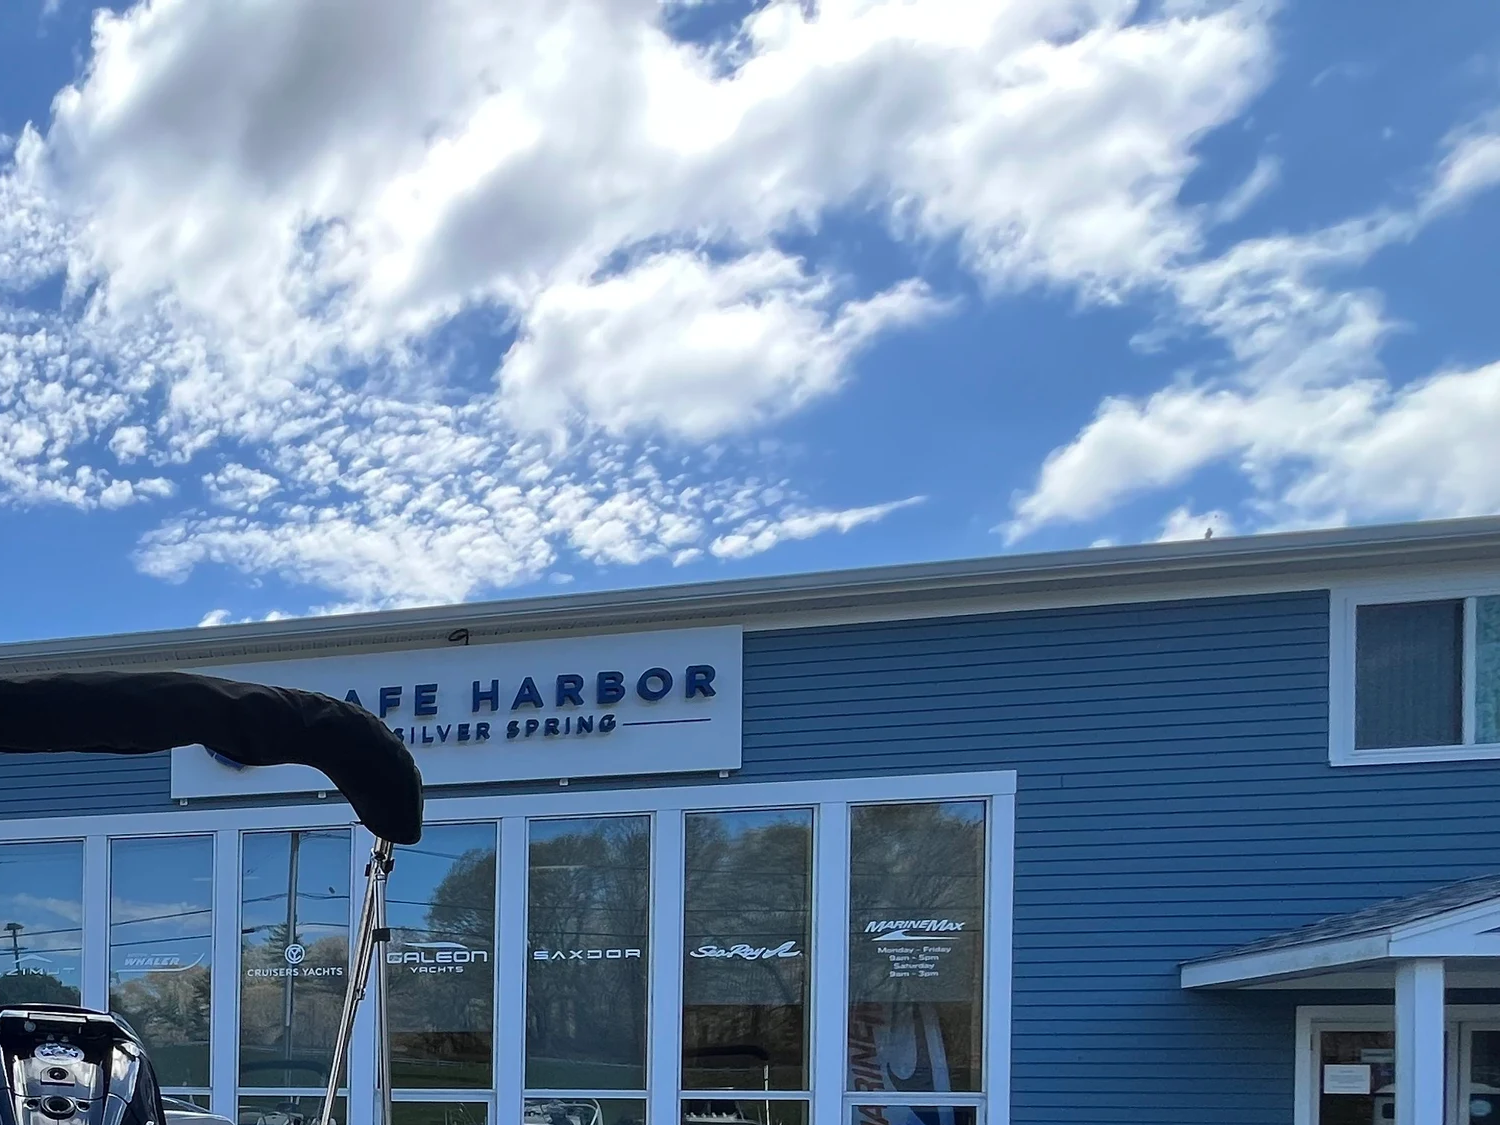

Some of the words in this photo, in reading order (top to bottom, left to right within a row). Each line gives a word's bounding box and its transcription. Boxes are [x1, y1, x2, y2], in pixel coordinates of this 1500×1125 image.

[345, 684, 439, 718] AFE
[471, 665, 716, 712] HARBOR
[393, 722, 491, 745] SILVER
[506, 714, 618, 739] SPRING
[386, 951, 488, 964] GALEON
[533, 949, 641, 960] SAXDOR
[124, 957, 180, 966] WHALER
[247, 968, 299, 977] CRUISERS
[302, 967, 343, 976] YACHTS
